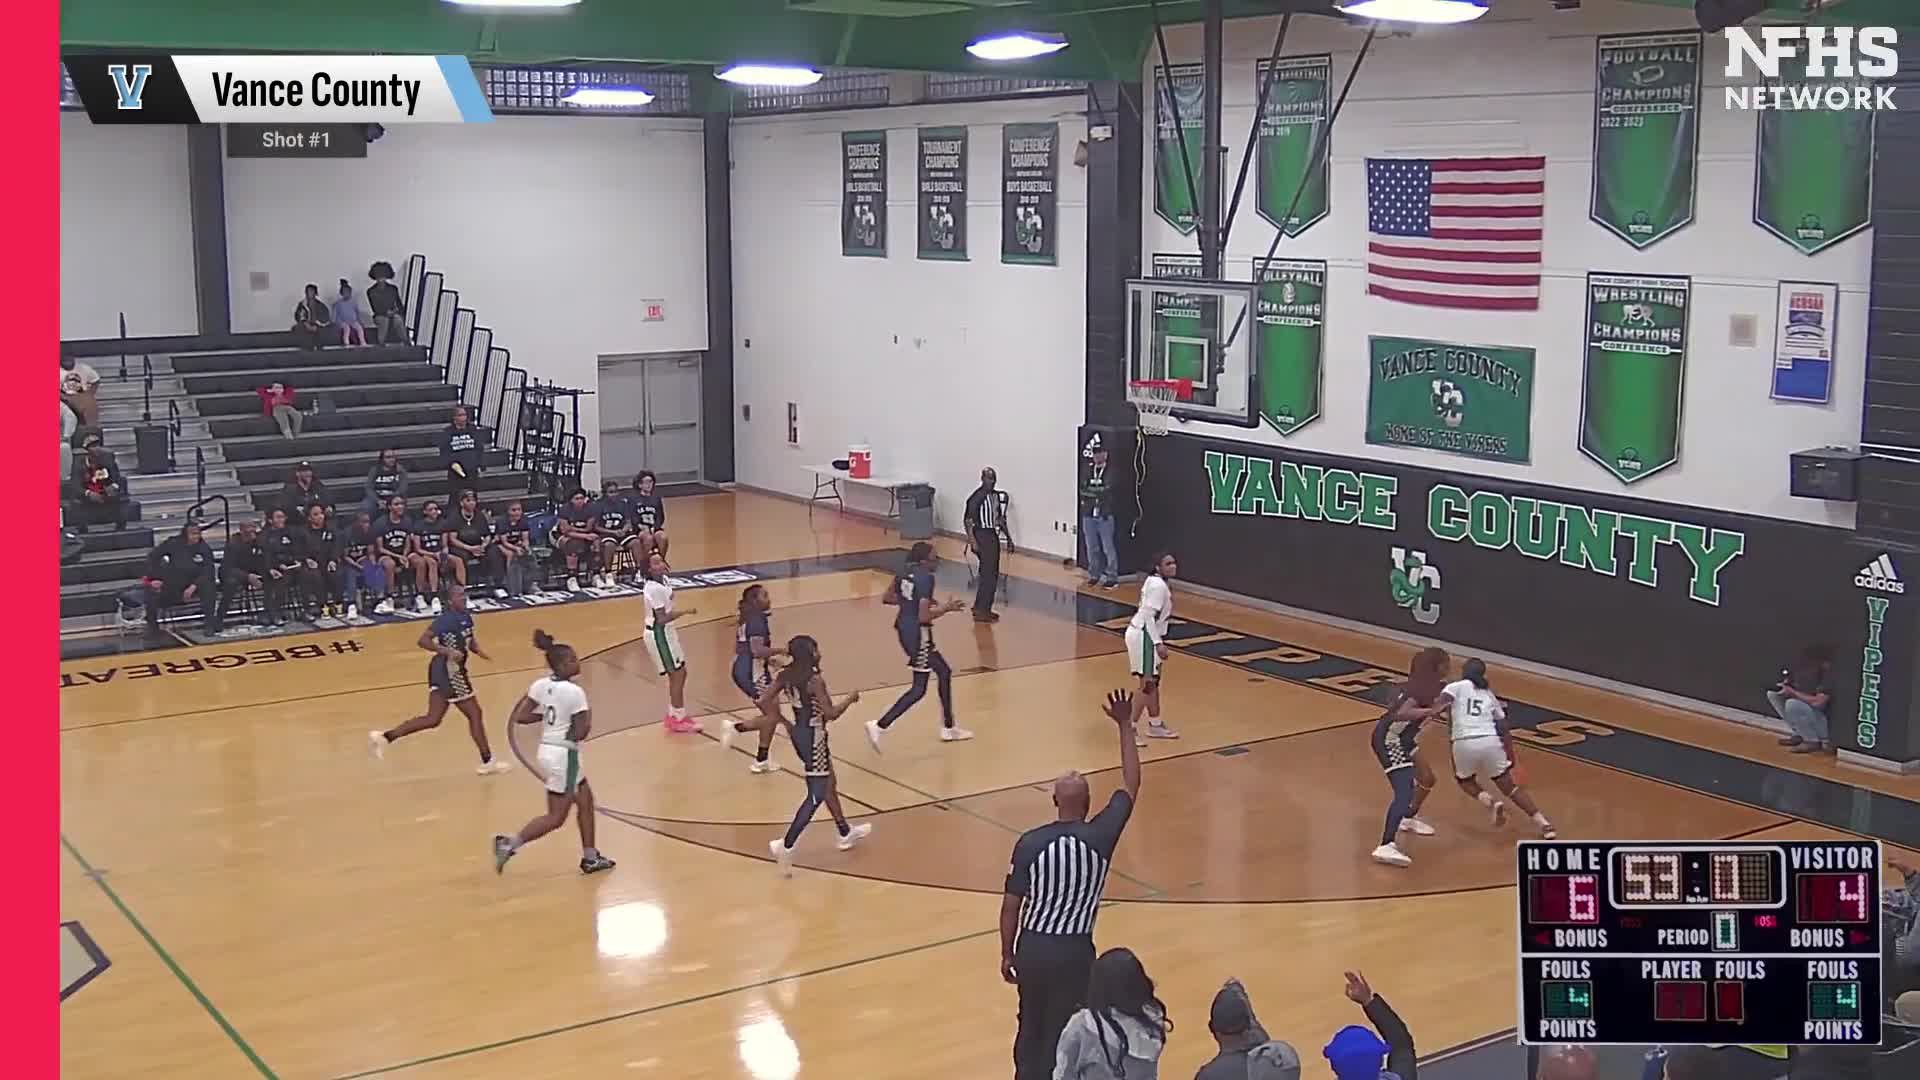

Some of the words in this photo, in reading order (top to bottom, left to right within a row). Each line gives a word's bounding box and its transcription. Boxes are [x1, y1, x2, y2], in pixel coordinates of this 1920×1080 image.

[1601, 47, 1696, 65] FOOTBALL
[1602, 83, 1692, 102] CHAMPIONS
[1009, 137, 1051, 152] CONFERENCE
[925, 155, 960, 168] CHAMPIONS
[1010, 153, 1049, 167] CHAMPIONS
[1593, 287, 1684, 307] WRESTLING
[1258, 300, 1321, 315] CHAMPIONS
[1593, 322, 1681, 342] CHAMPIONS
[1379, 348, 1438, 381] VANCE
[1444, 348, 1522, 397] COUNTY
[1204, 450, 1398, 530] VANCE
[1428, 484, 1744, 606] COUNTY
[1854, 575, 1904, 594] adidas
[1857, 596, 1889, 749] VIPERS
[1466, 697, 1483, 717] 15
